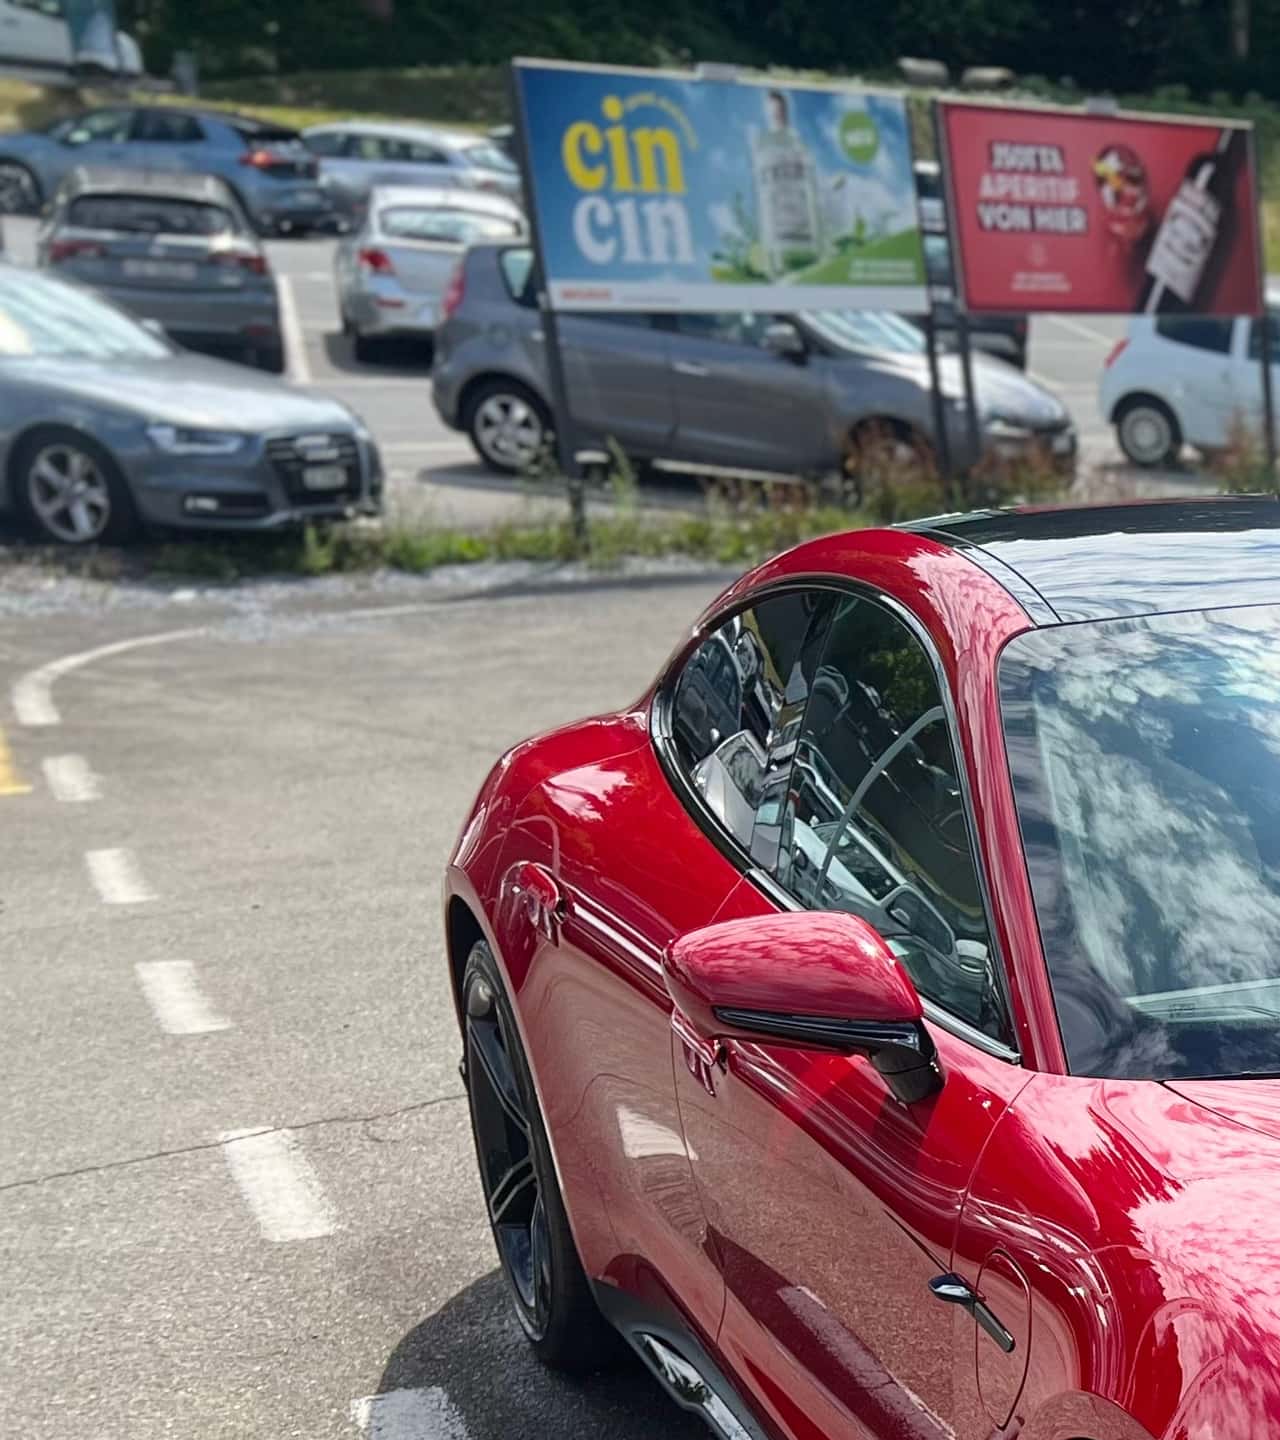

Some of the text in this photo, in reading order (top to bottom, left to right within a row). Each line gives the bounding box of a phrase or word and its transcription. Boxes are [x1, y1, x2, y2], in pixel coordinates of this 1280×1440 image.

[562, 96, 687, 194] cin
[979, 174, 1079, 202] APERITIF
[977, 204, 1088, 233] VON HIER
